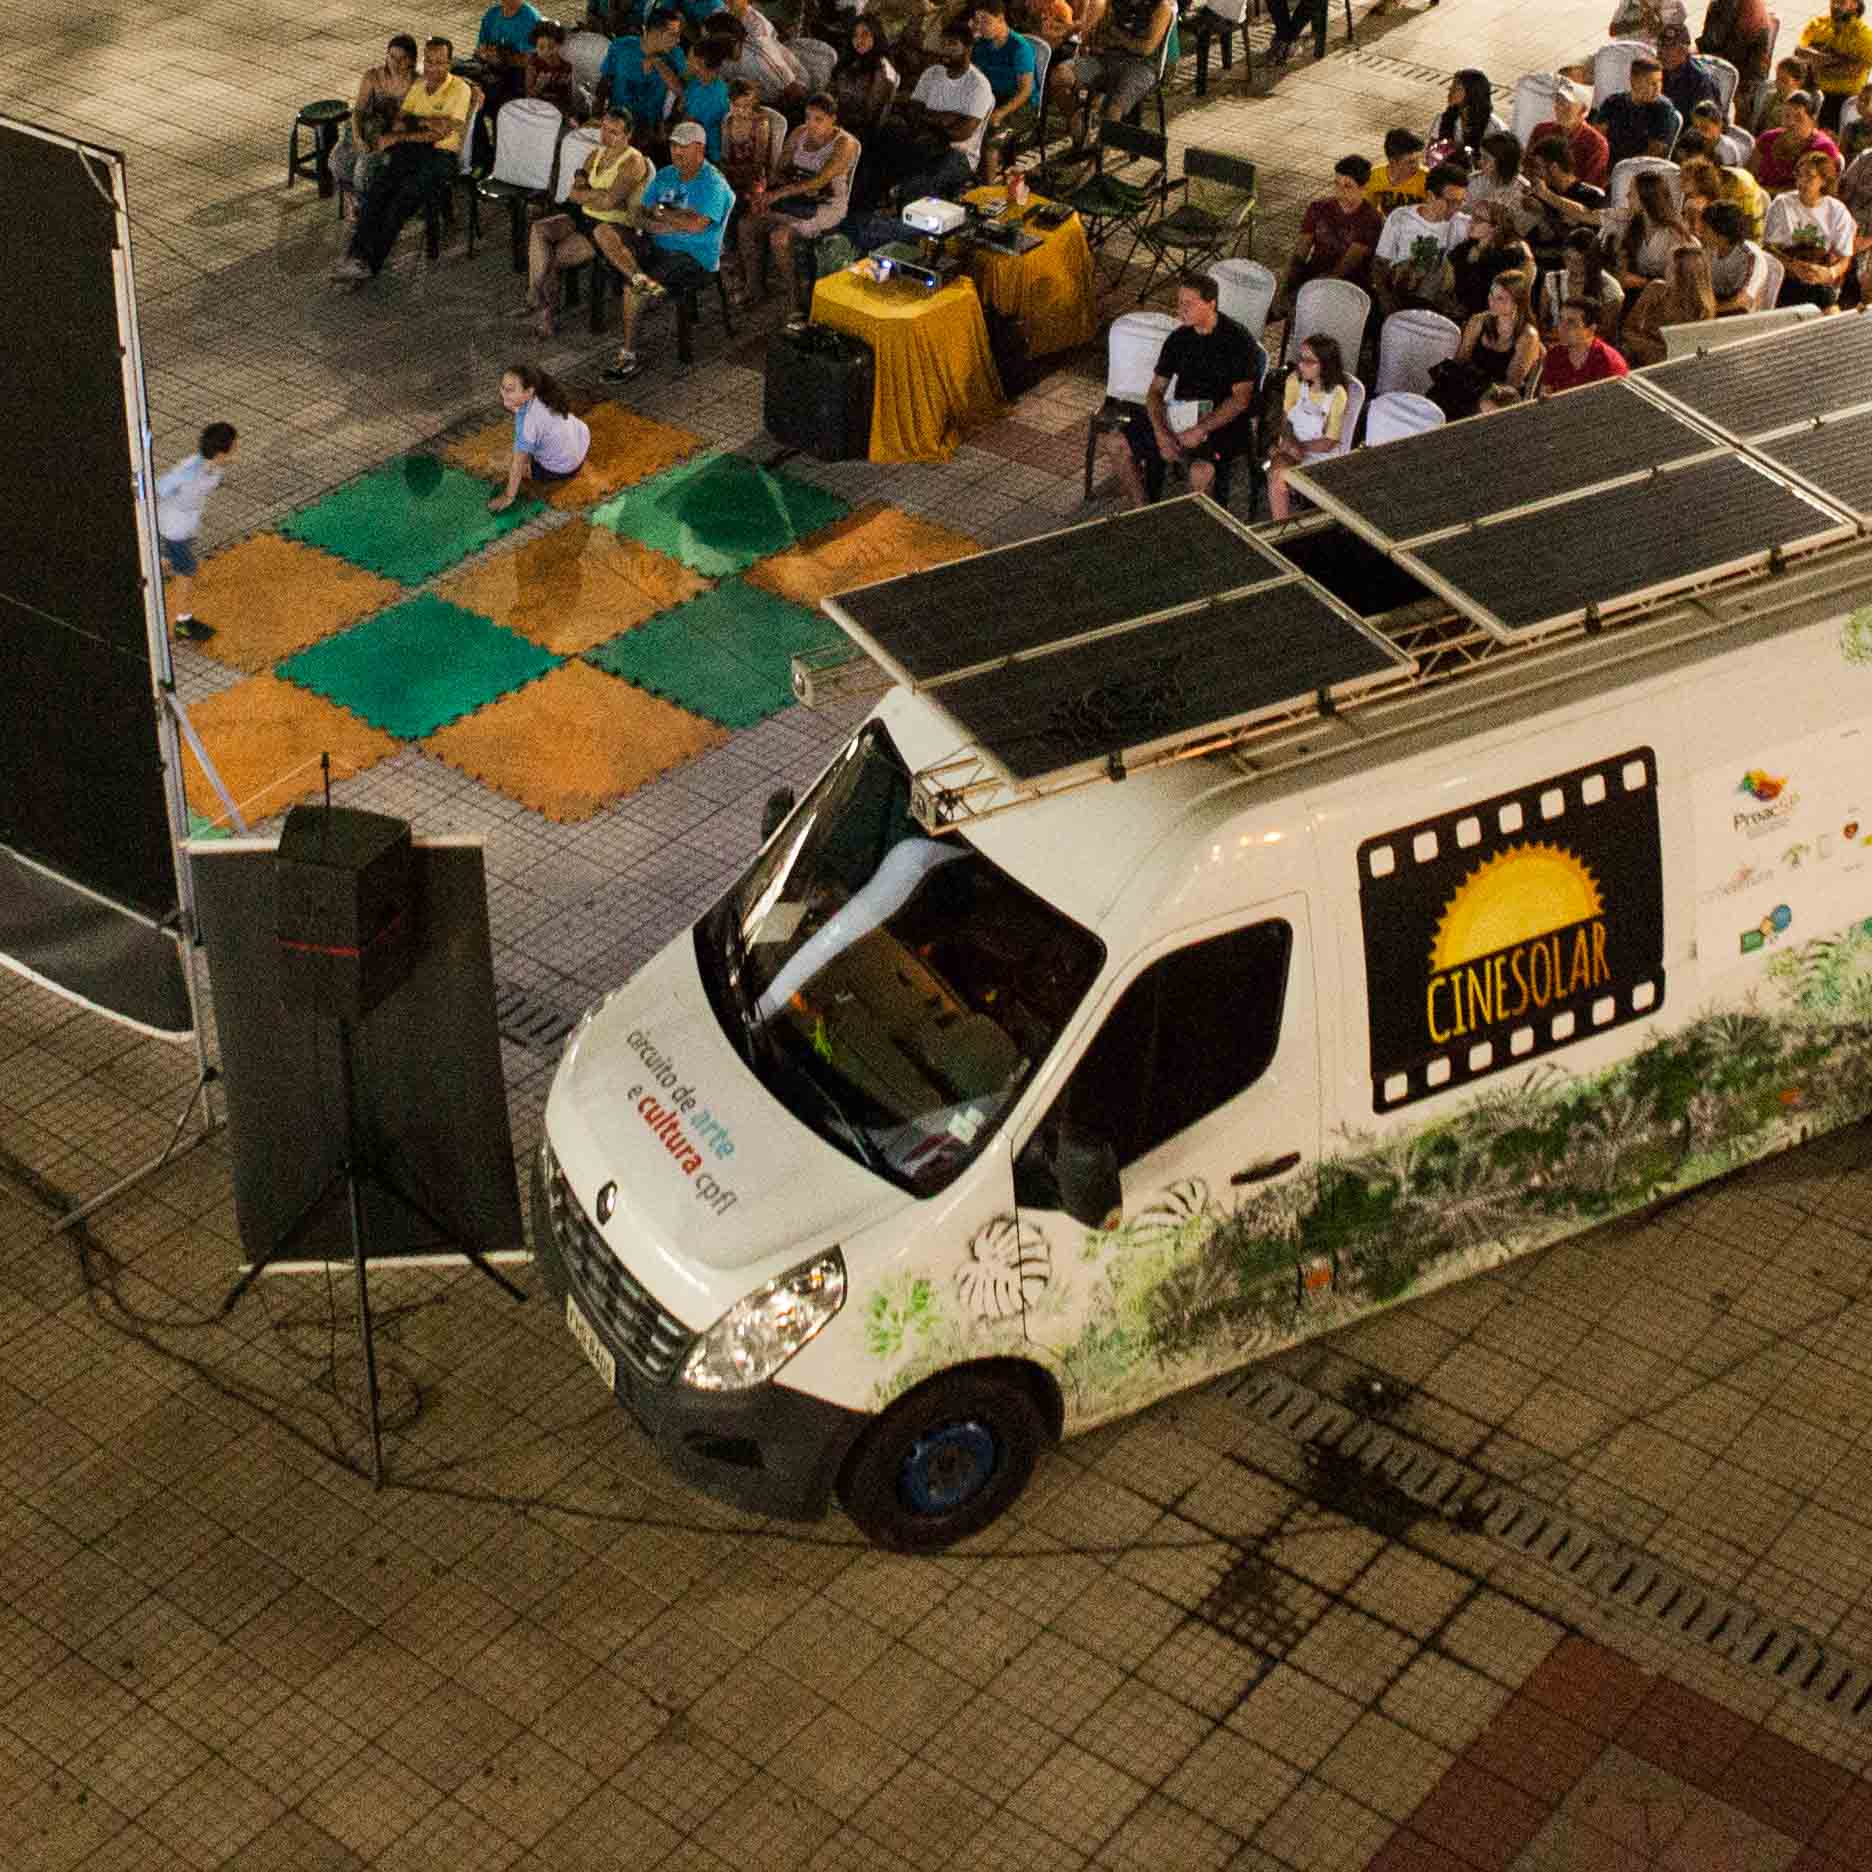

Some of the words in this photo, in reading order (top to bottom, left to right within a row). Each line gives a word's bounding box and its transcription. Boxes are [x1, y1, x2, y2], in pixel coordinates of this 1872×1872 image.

[1427, 921, 1611, 1043] CINESOLAR
[627, 1030, 678, 1089] circuito
[671, 1085, 697, 1114] de
[690, 1107, 736, 1160] arte
[627, 1084, 644, 1101] e
[638, 1094, 704, 1176] cultura
[695, 1172, 738, 1217] cpfl
